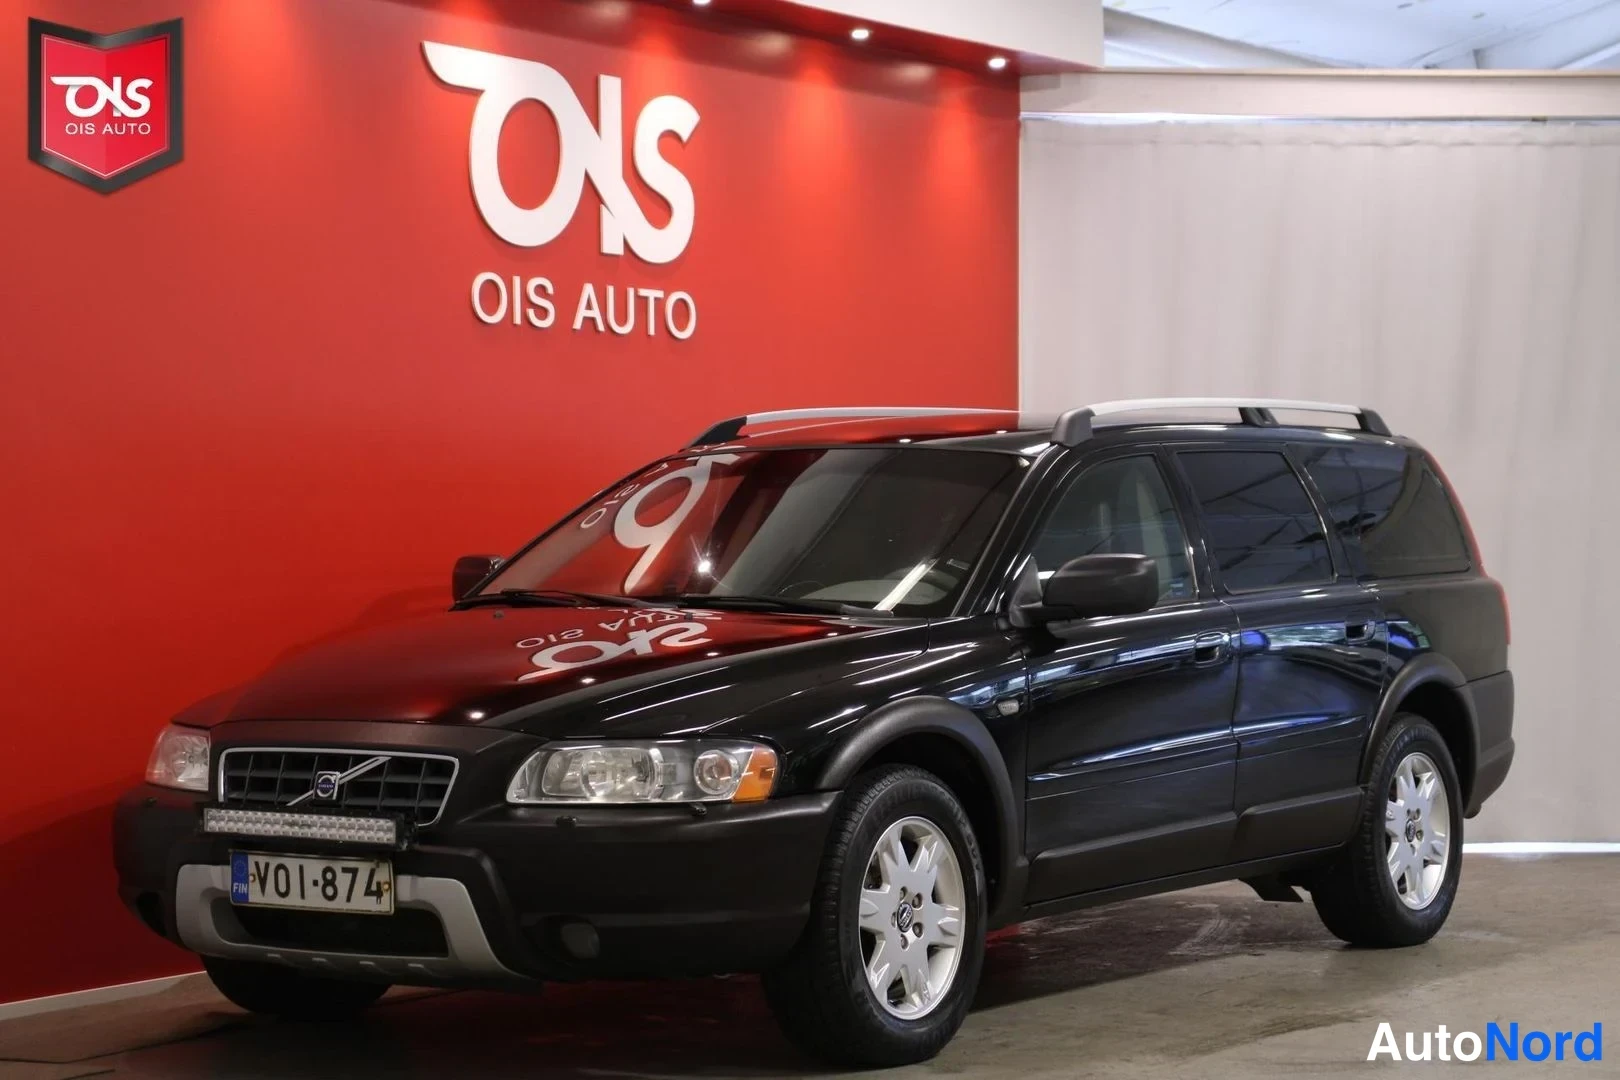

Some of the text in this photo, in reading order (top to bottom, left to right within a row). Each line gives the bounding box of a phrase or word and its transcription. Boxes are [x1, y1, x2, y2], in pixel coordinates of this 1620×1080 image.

[471, 271, 697, 340] OIS AUTO
[232, 882, 248, 894] FIN
[254, 861, 383, 904] VOI-874
